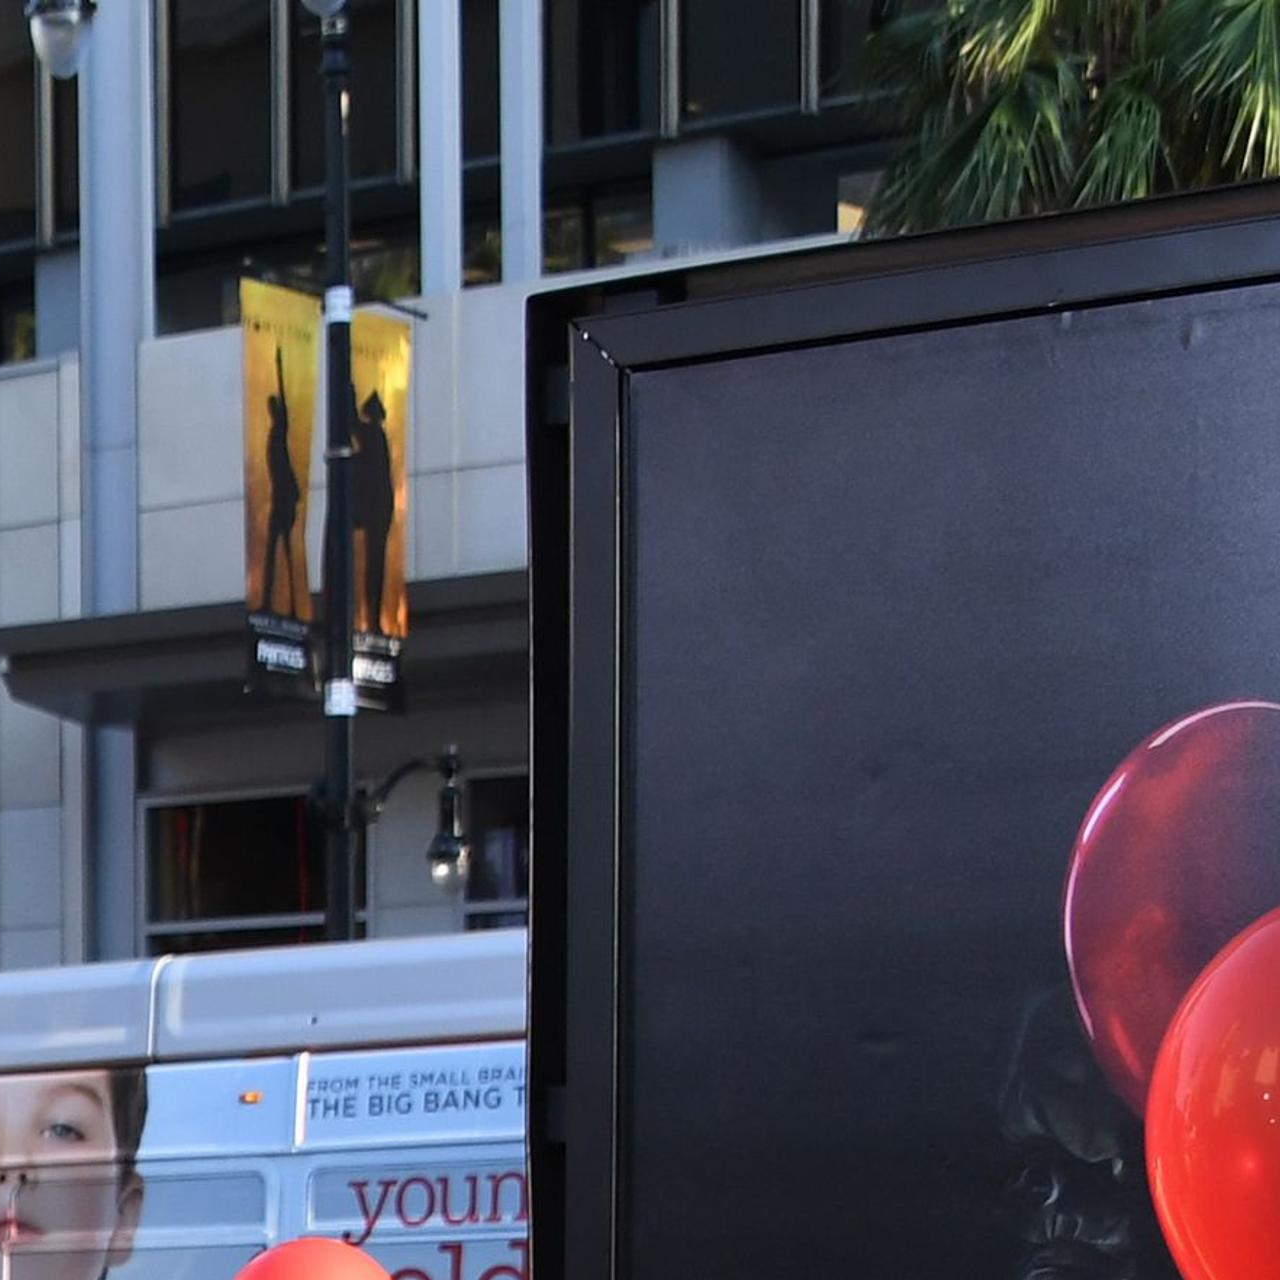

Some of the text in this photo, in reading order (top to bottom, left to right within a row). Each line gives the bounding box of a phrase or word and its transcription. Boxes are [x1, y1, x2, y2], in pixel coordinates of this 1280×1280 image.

[308, 1077, 359, 1093] FROM
[368, 1074, 401, 1090] THE
[410, 1068, 470, 1089] SMALL
[308, 1096, 357, 1119] THE
[368, 1092, 412, 1117] BIG
[424, 1087, 502, 1113] BANG
